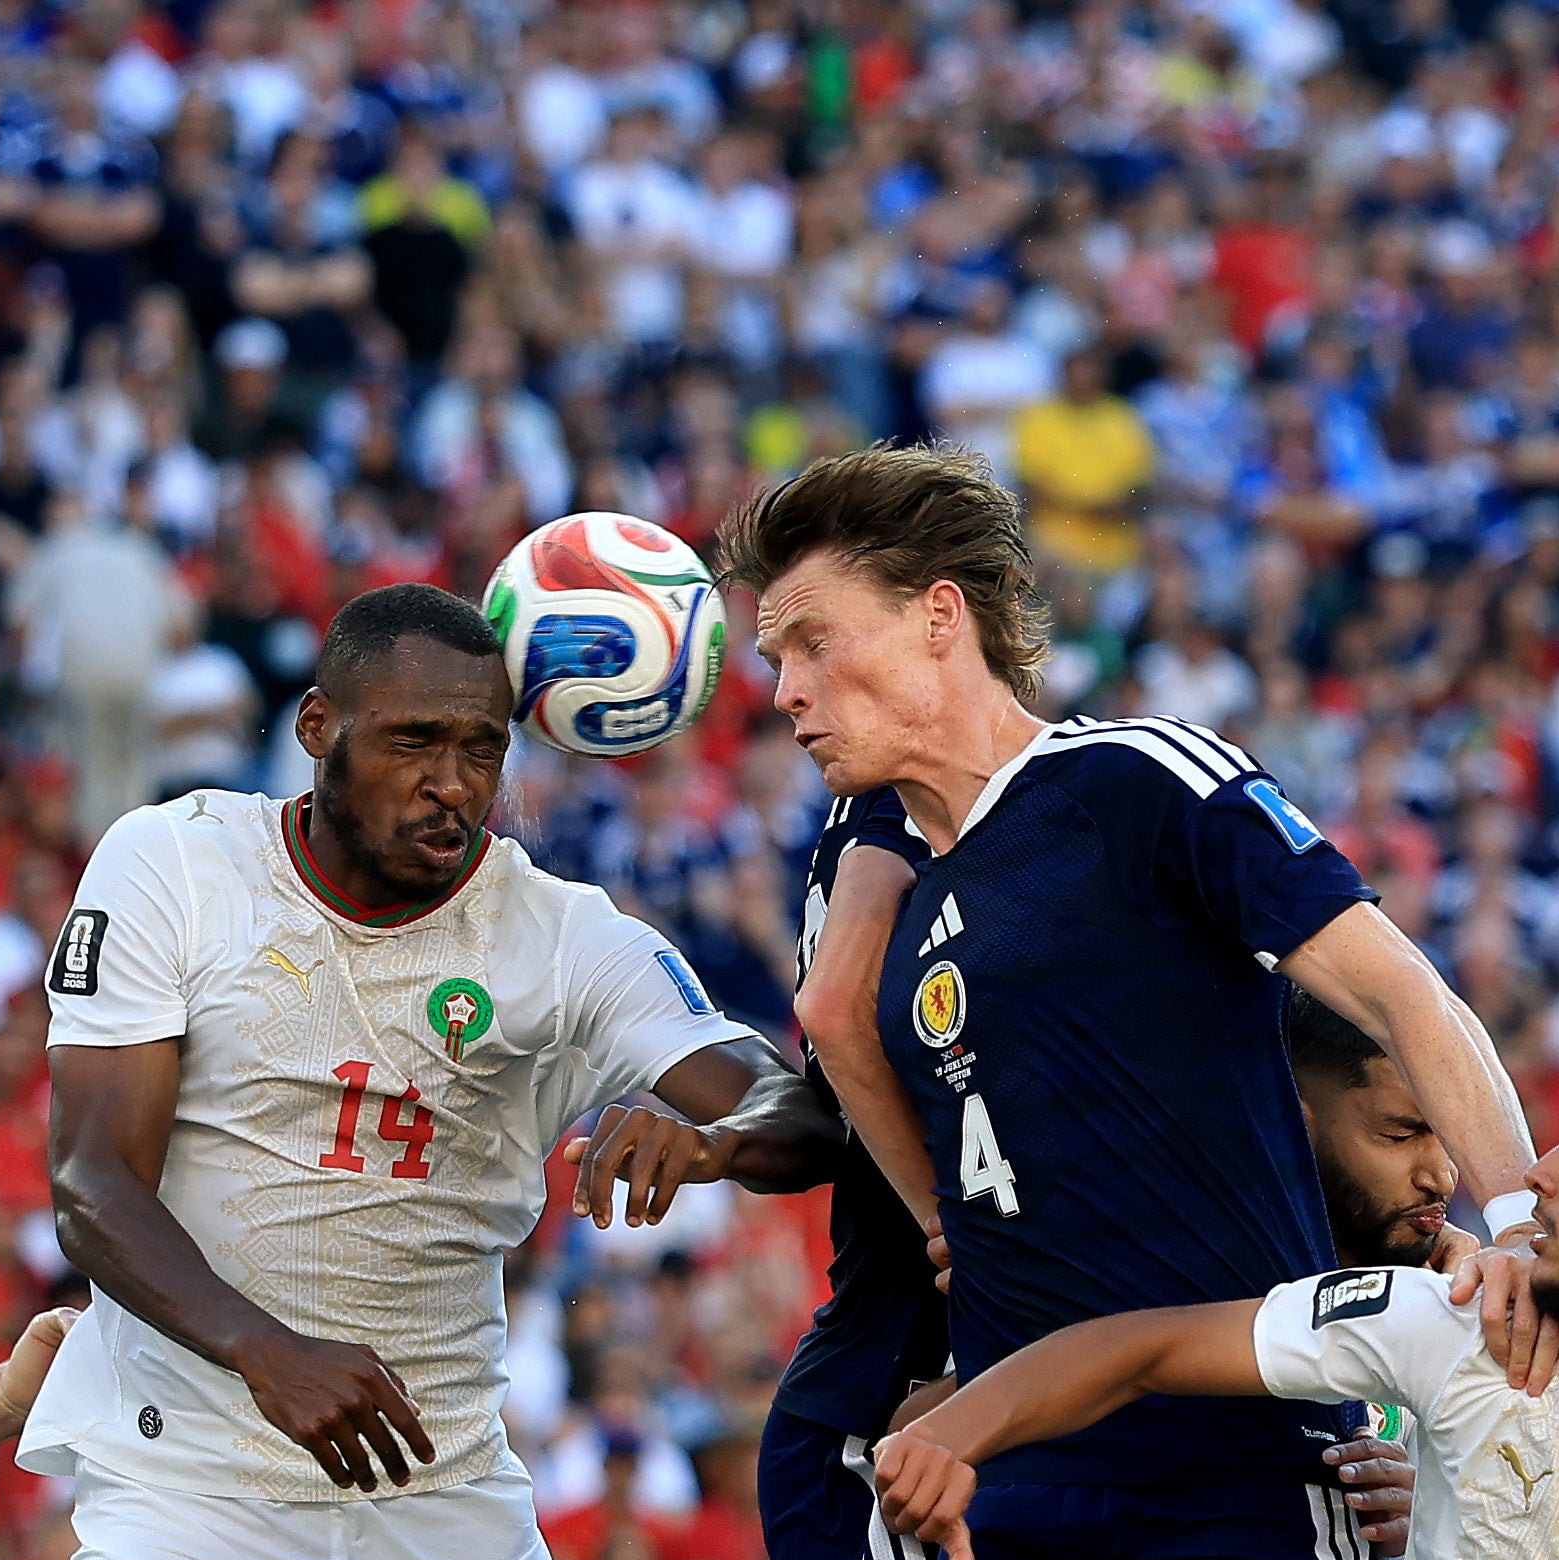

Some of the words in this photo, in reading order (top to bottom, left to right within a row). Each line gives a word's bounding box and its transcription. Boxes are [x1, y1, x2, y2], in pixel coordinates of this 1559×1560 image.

[62, 979, 88, 989] 2026
[944, 1059, 961, 1074] JUNE
[945, 1067, 972, 1084] BOSTON
[319, 1060, 435, 1179] 14
[959, 1093, 1021, 1218] 4
